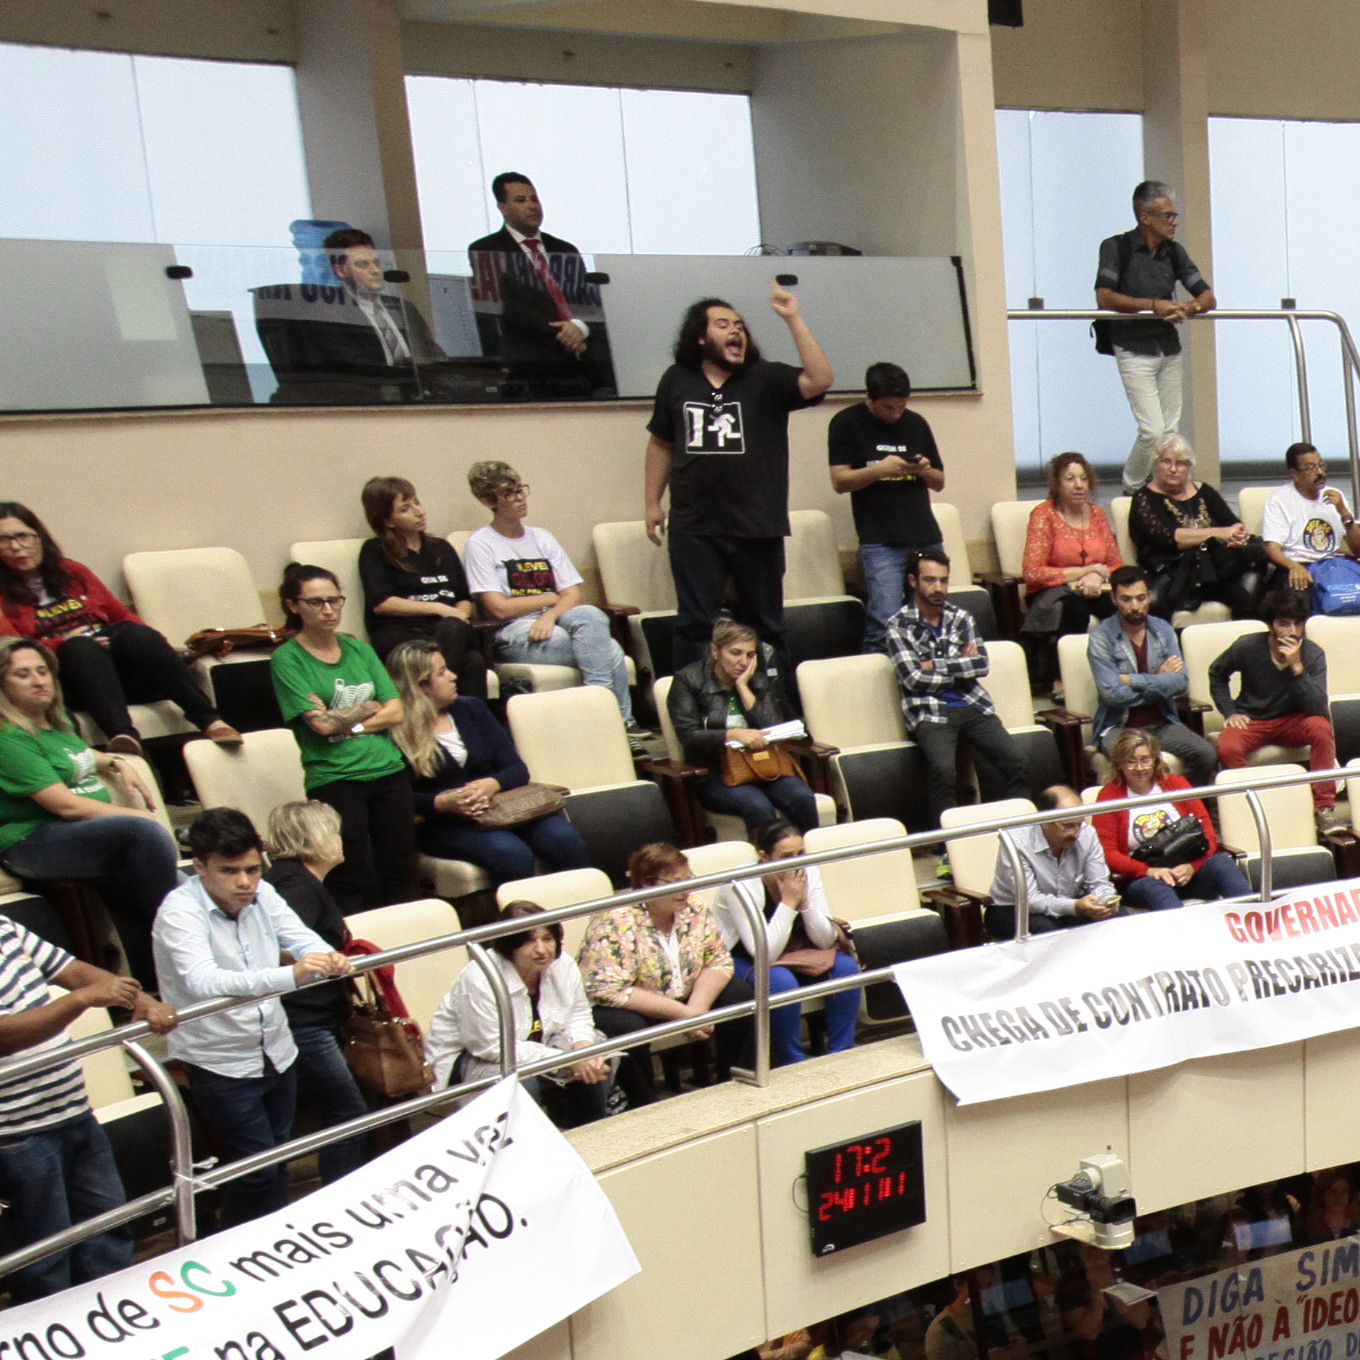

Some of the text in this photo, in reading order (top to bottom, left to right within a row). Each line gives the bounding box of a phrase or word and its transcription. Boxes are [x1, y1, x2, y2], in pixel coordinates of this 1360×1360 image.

[941, 1006, 1051, 1053] CHEGA
[1044, 996, 1088, 1034] DE
[1084, 968, 1232, 1029] CONTRATO
[86, 1291, 161, 1343] de
[148, 1260, 237, 1313] SC
[229, 1221, 354, 1283] mais
[345, 1162, 459, 1231] uma
[446, 1111, 514, 1168] vez
[272, 1192, 530, 1352] EDUCAÇÃO.
[1182, 1267, 1264, 1326] DIGA
[1296, 1243, 1359, 1292] SIM
[1272, 1299, 1291, 1343] À
